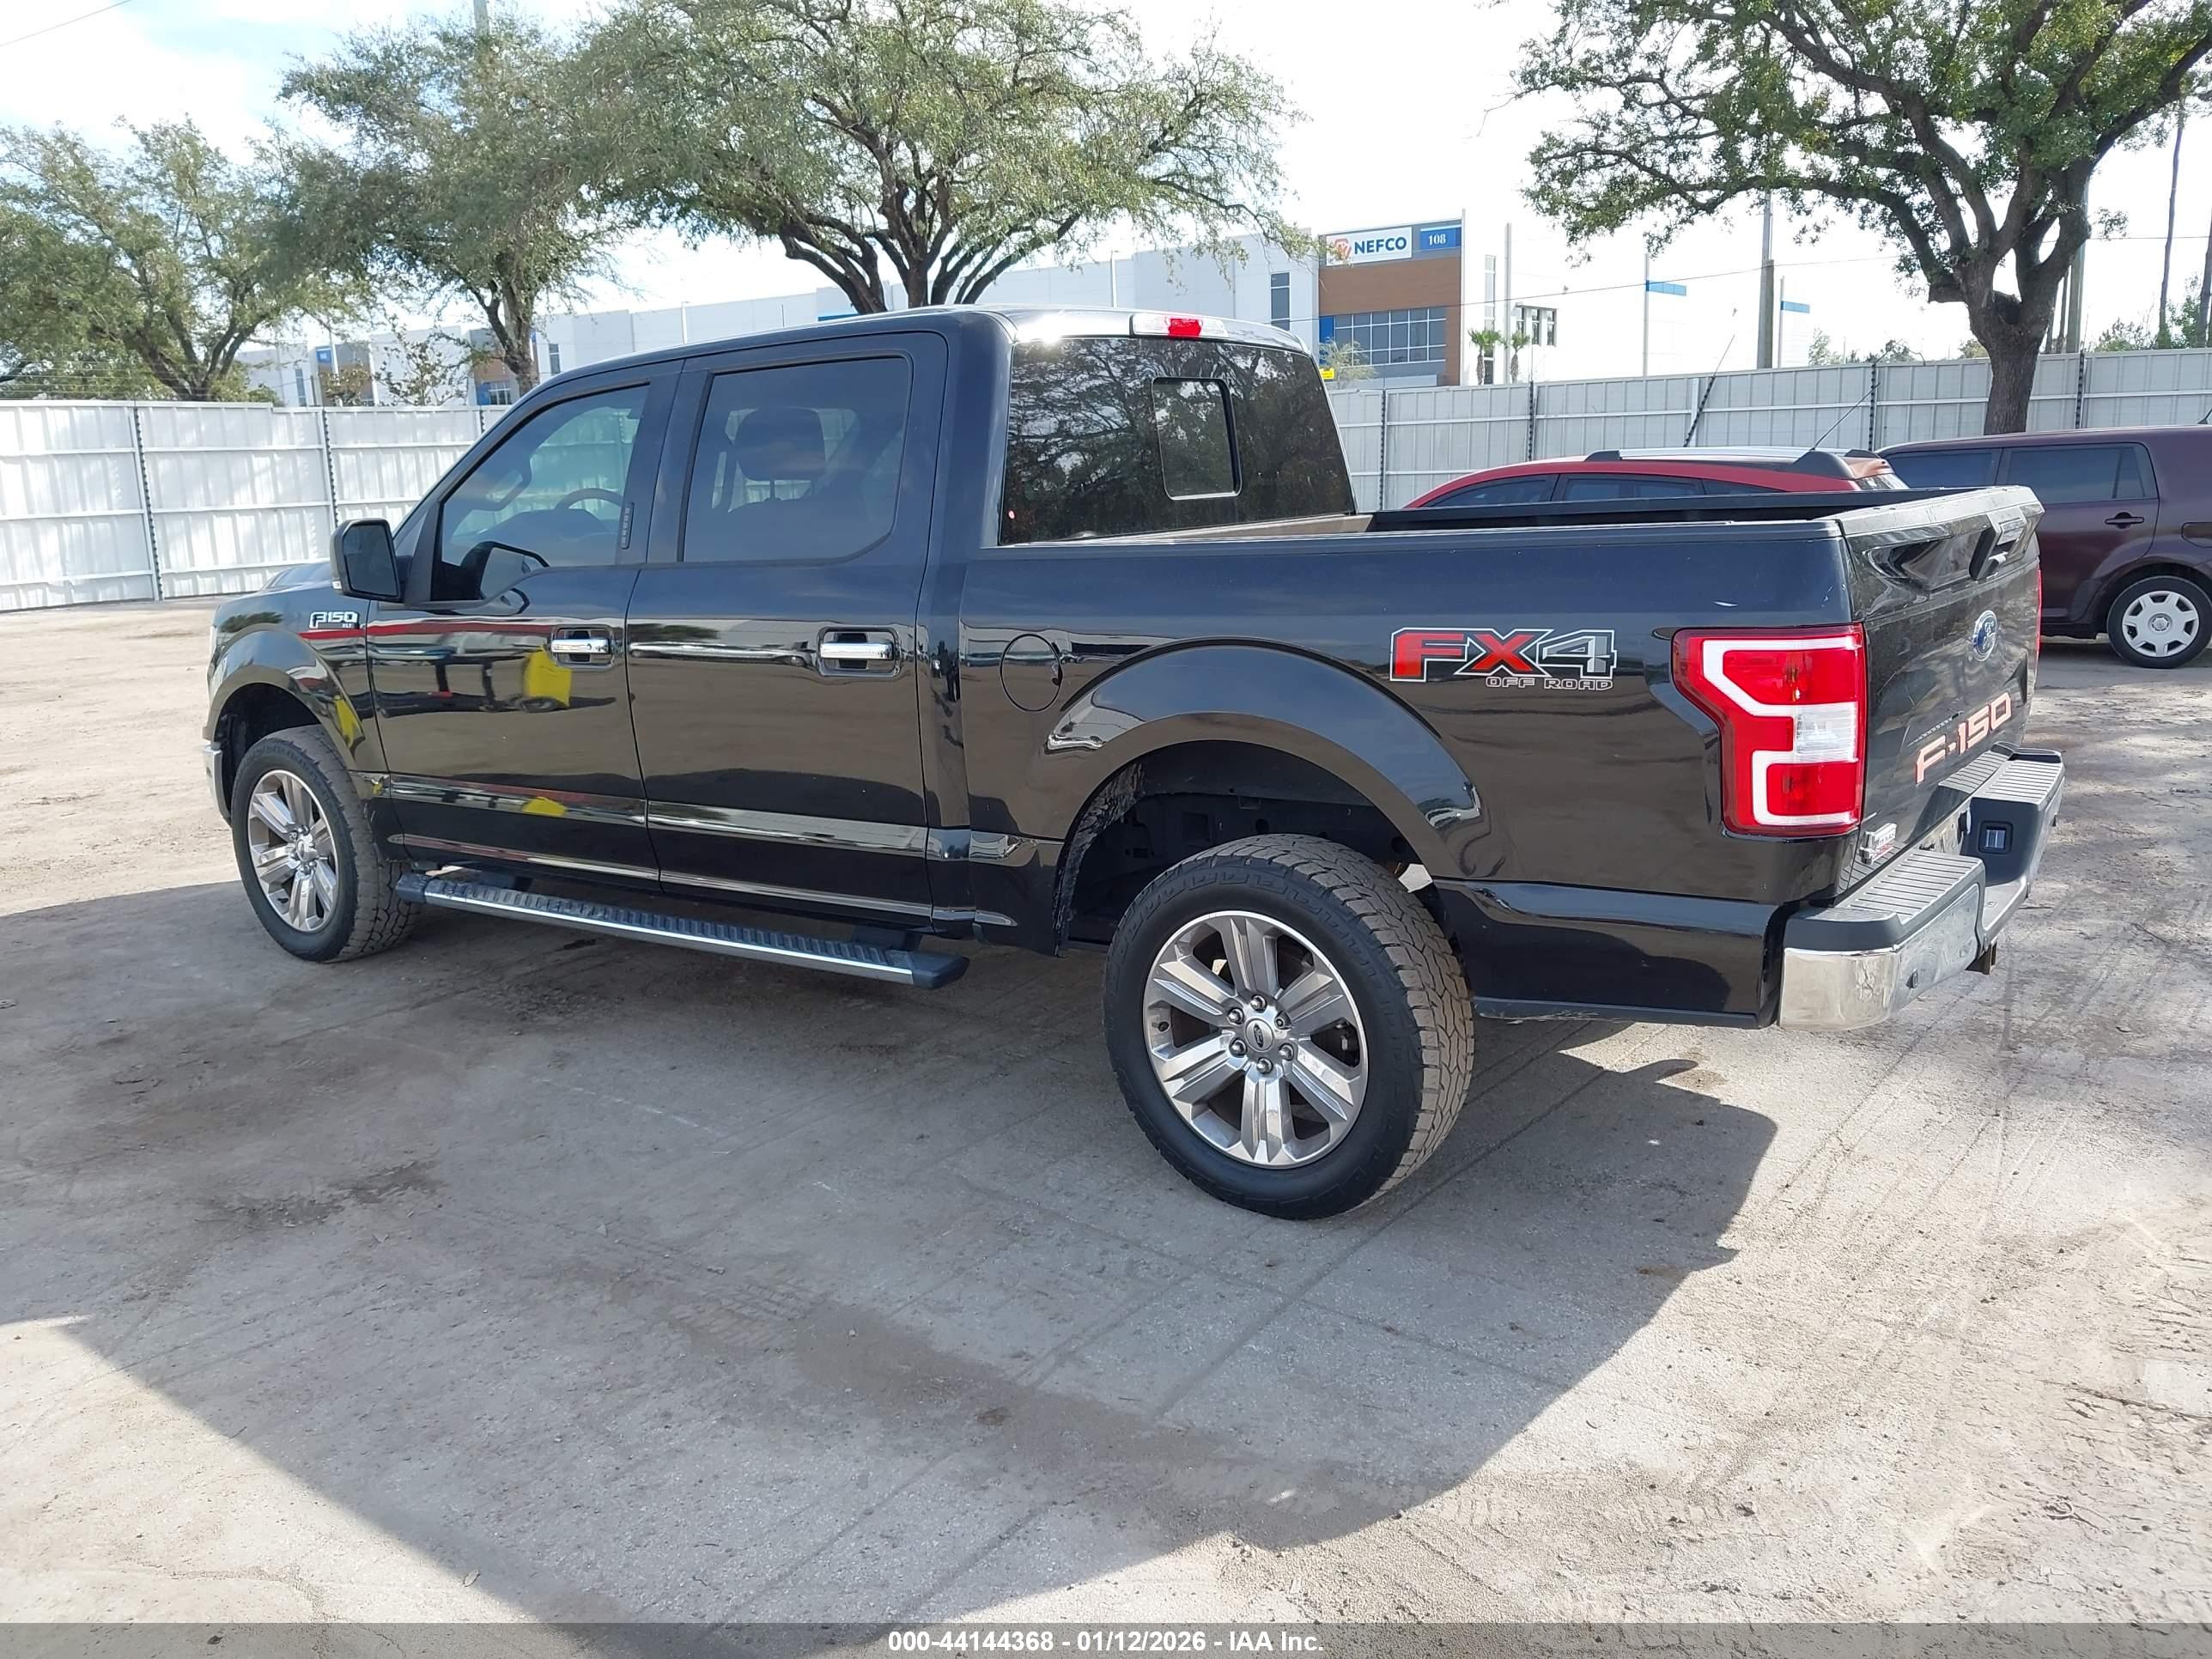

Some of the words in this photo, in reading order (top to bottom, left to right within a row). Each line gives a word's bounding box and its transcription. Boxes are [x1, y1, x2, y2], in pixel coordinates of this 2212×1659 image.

[1354, 236, 1407, 255] NEFCO
[1428, 234, 1447, 246] 108
[1389, 627, 1617, 682] FX4
[1485, 676, 1535, 689] OFF
[1543, 678, 1613, 691] ROAD
[1916, 691, 2012, 785] F-150
